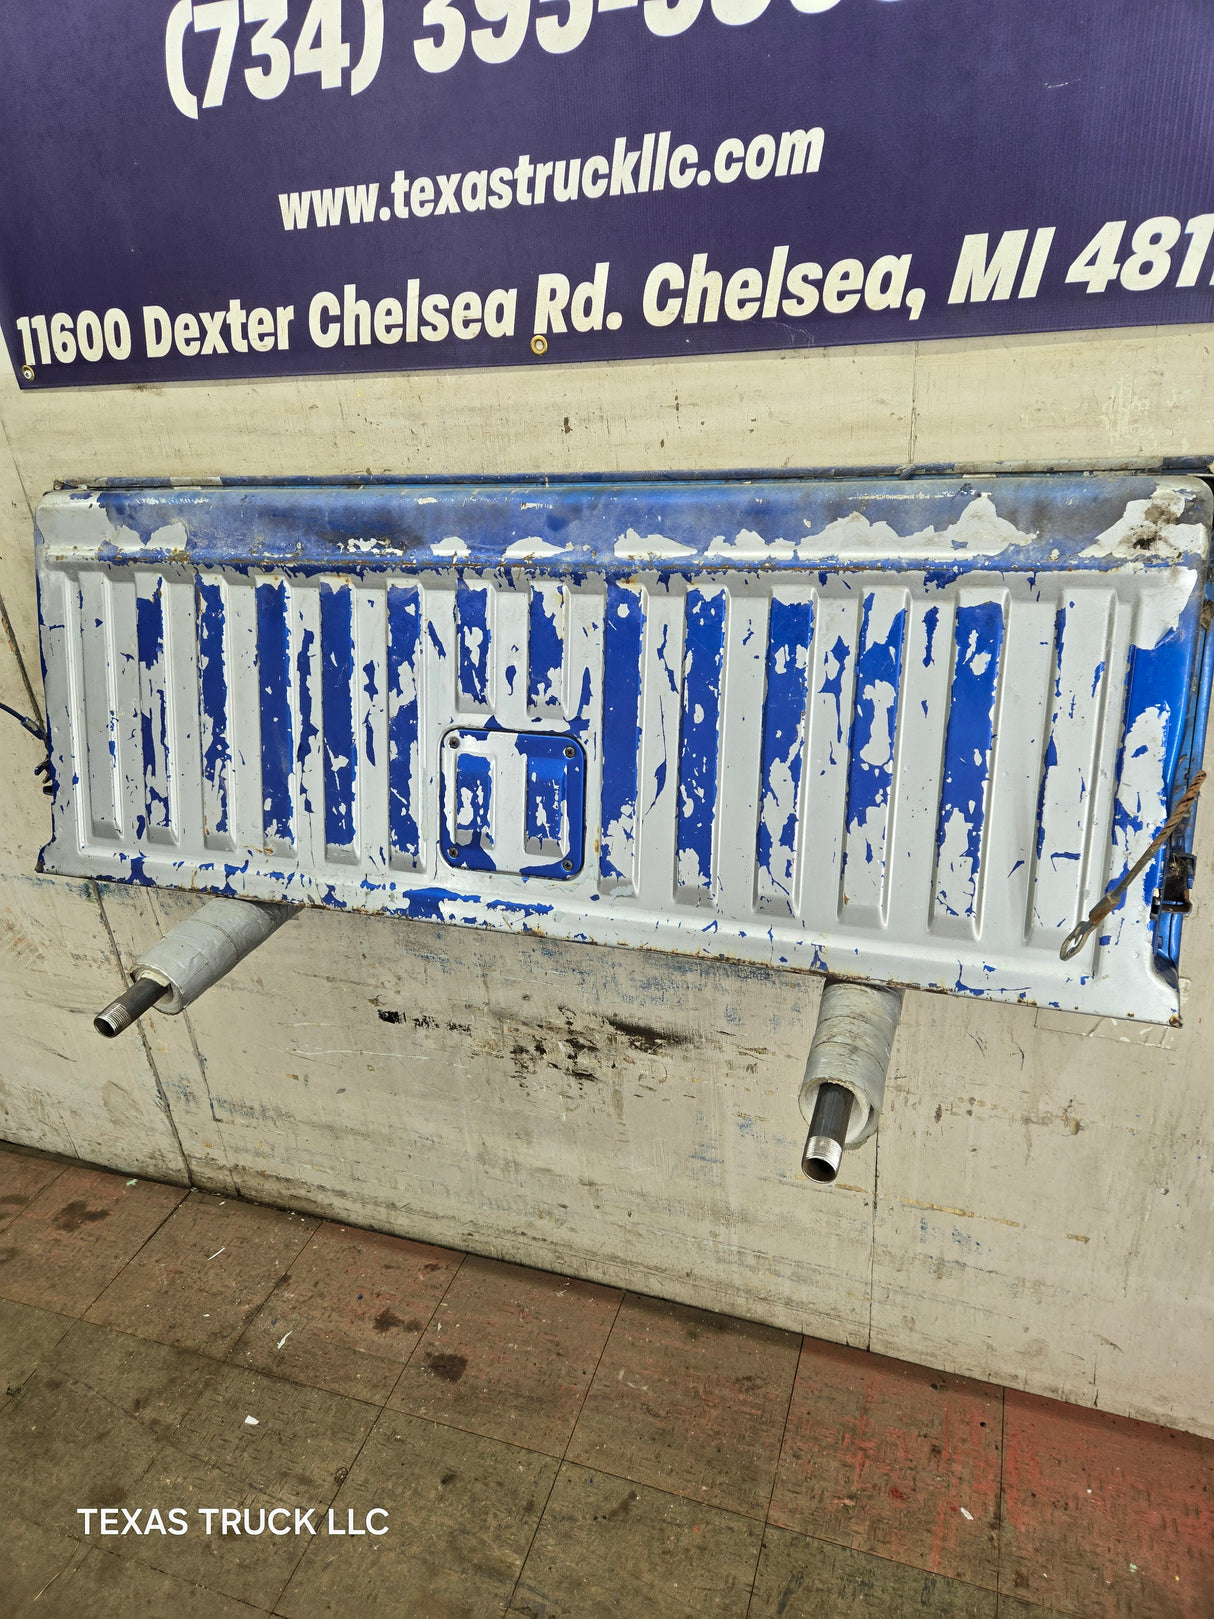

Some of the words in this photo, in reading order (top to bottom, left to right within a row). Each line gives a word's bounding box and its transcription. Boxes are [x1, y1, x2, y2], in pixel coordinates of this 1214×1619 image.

[165, 0, 384, 119] (734)
[278, 126, 825, 231] www.texastruckllc.com
[16, 307, 132, 366] 11600
[143, 298, 295, 358] Dexter
[308, 278, 518, 349] Chelsea
[533, 261, 623, 335] Rd.
[642, 245, 926, 327] Chelsea,
[947, 226, 1057, 305] MI
[1064, 213, 1214, 294] 481
